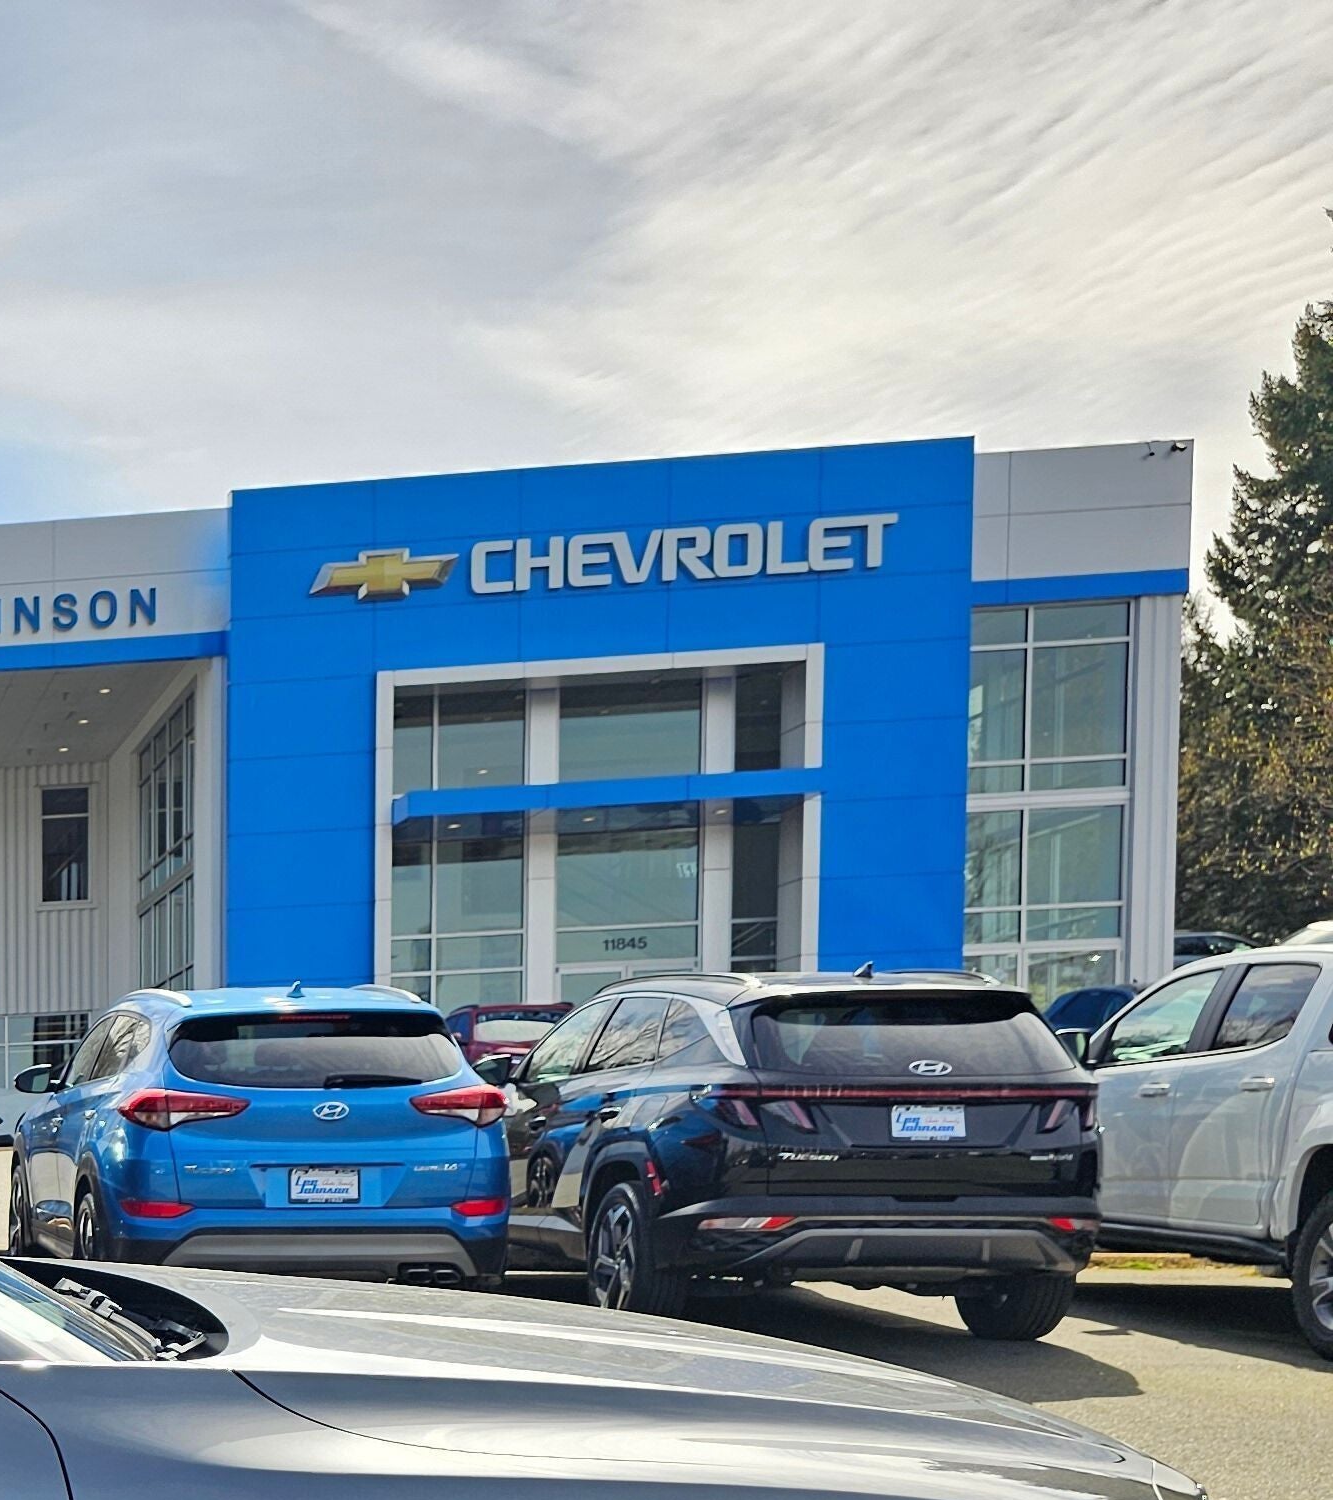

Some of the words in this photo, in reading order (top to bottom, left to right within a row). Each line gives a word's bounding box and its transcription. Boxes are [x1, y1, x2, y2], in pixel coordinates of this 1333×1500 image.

[470, 513, 898, 595] CHEVROLET
[602, 936, 648, 951] 11845
[895, 1112, 921, 1124] Lee
[295, 1175, 318, 1187] Lee
